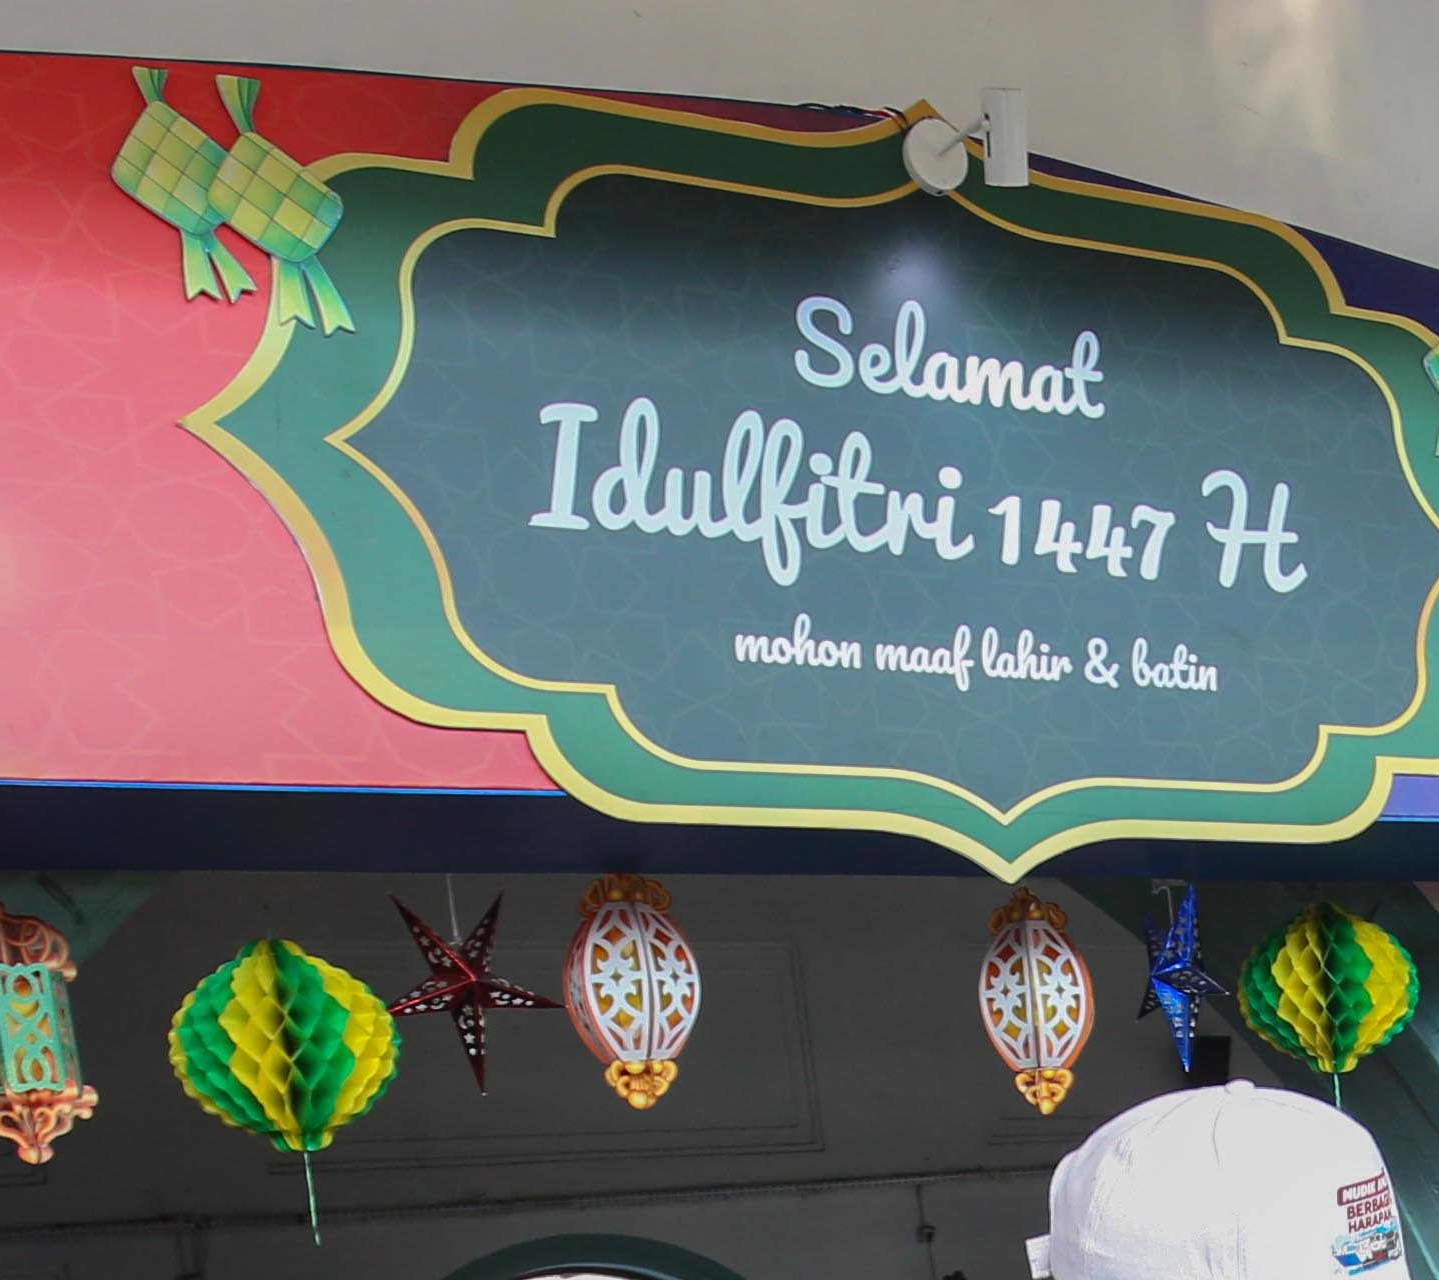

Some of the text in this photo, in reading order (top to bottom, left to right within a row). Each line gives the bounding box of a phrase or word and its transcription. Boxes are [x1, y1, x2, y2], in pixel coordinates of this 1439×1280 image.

[795, 296, 1105, 420] Selamat
[529, 397, 1307, 594] Idulfitri 1447 H
[734, 614, 1219, 693] mohon maaf lahir & batin
